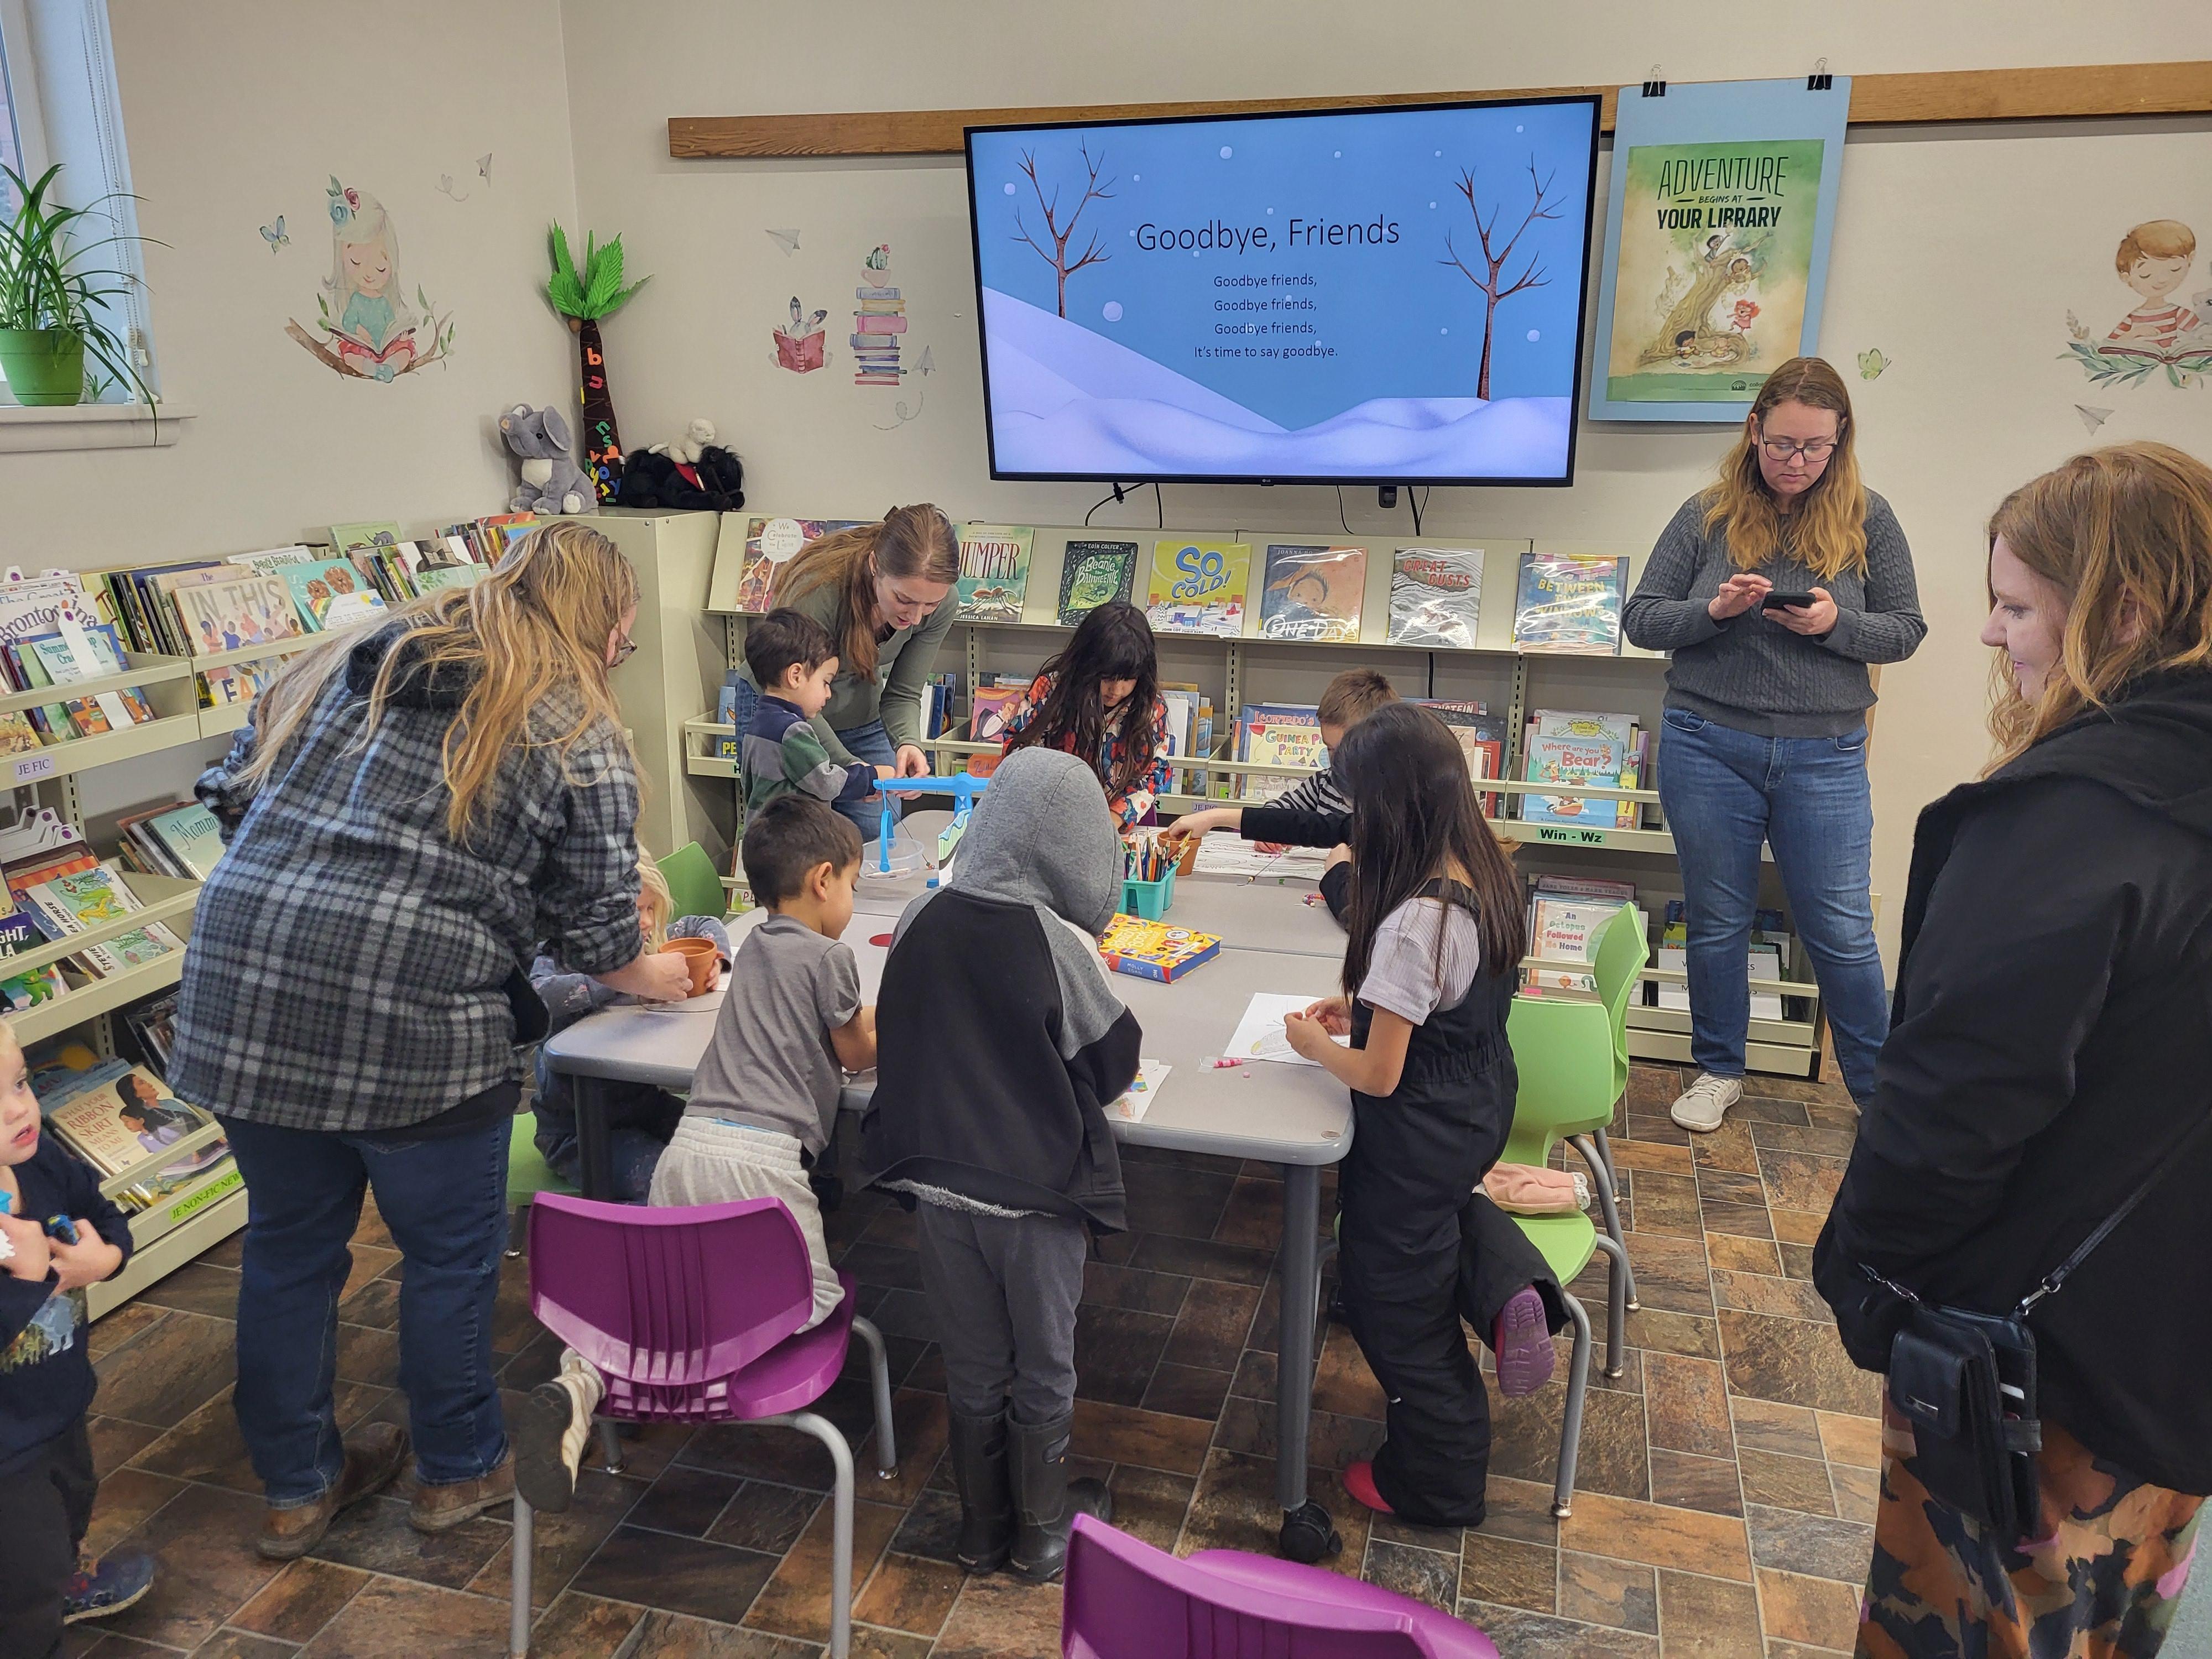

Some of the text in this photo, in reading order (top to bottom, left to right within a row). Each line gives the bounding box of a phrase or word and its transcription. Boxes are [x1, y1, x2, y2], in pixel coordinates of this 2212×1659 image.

[1657, 156, 1788, 200] ADVENTURE
[1699, 195, 1729, 204] BEGINS
[1657, 207, 1781, 229] YOUR LIBRARY
[1136, 213, 1399, 255] Goodbye, Friends
[1214, 273, 1317, 288] Goodbye friends,
[1214, 298, 1317, 312] Goodbye friends,
[1215, 321, 1316, 336] Goodbye friends,
[1194, 345, 1338, 359] It's time to say goodbye.
[768, 530, 796, 540] Celebrate
[959, 541, 1020, 580] JUMPER
[1084, 556, 1115, 572] Beanie
[1176, 546, 1223, 583] SO
[1404, 560, 1447, 572] GREAT
[200, 573, 213, 581] The
[1172, 570, 1232, 598] COLD!
[1428, 573, 1470, 587] GUSTS
[1538, 578, 1605, 594] BETWEEN
[188, 589, 221, 623] IN
[223, 580, 286, 615] THIS
[1265, 730, 1309, 744] GUINEA
[1279, 744, 1313, 757] PARTY
[1542, 742, 1571, 752] Where
[18, 759, 49, 775] JE FIC
[1562, 752, 1611, 769] Bear?
[1541, 829, 1567, 840] Win
[1582, 832, 1602, 842] Wz
[1550, 920, 1585, 931] Octopus
[1547, 931, 1583, 941] Followed
[1559, 942, 1582, 951] Home
[67, 1102, 115, 1130] RIBBON
[79, 1117, 113, 1137] SKIRT
[173, 1207, 181, 1218] JE
[184, 1184, 220, 1211] NON-FIC
